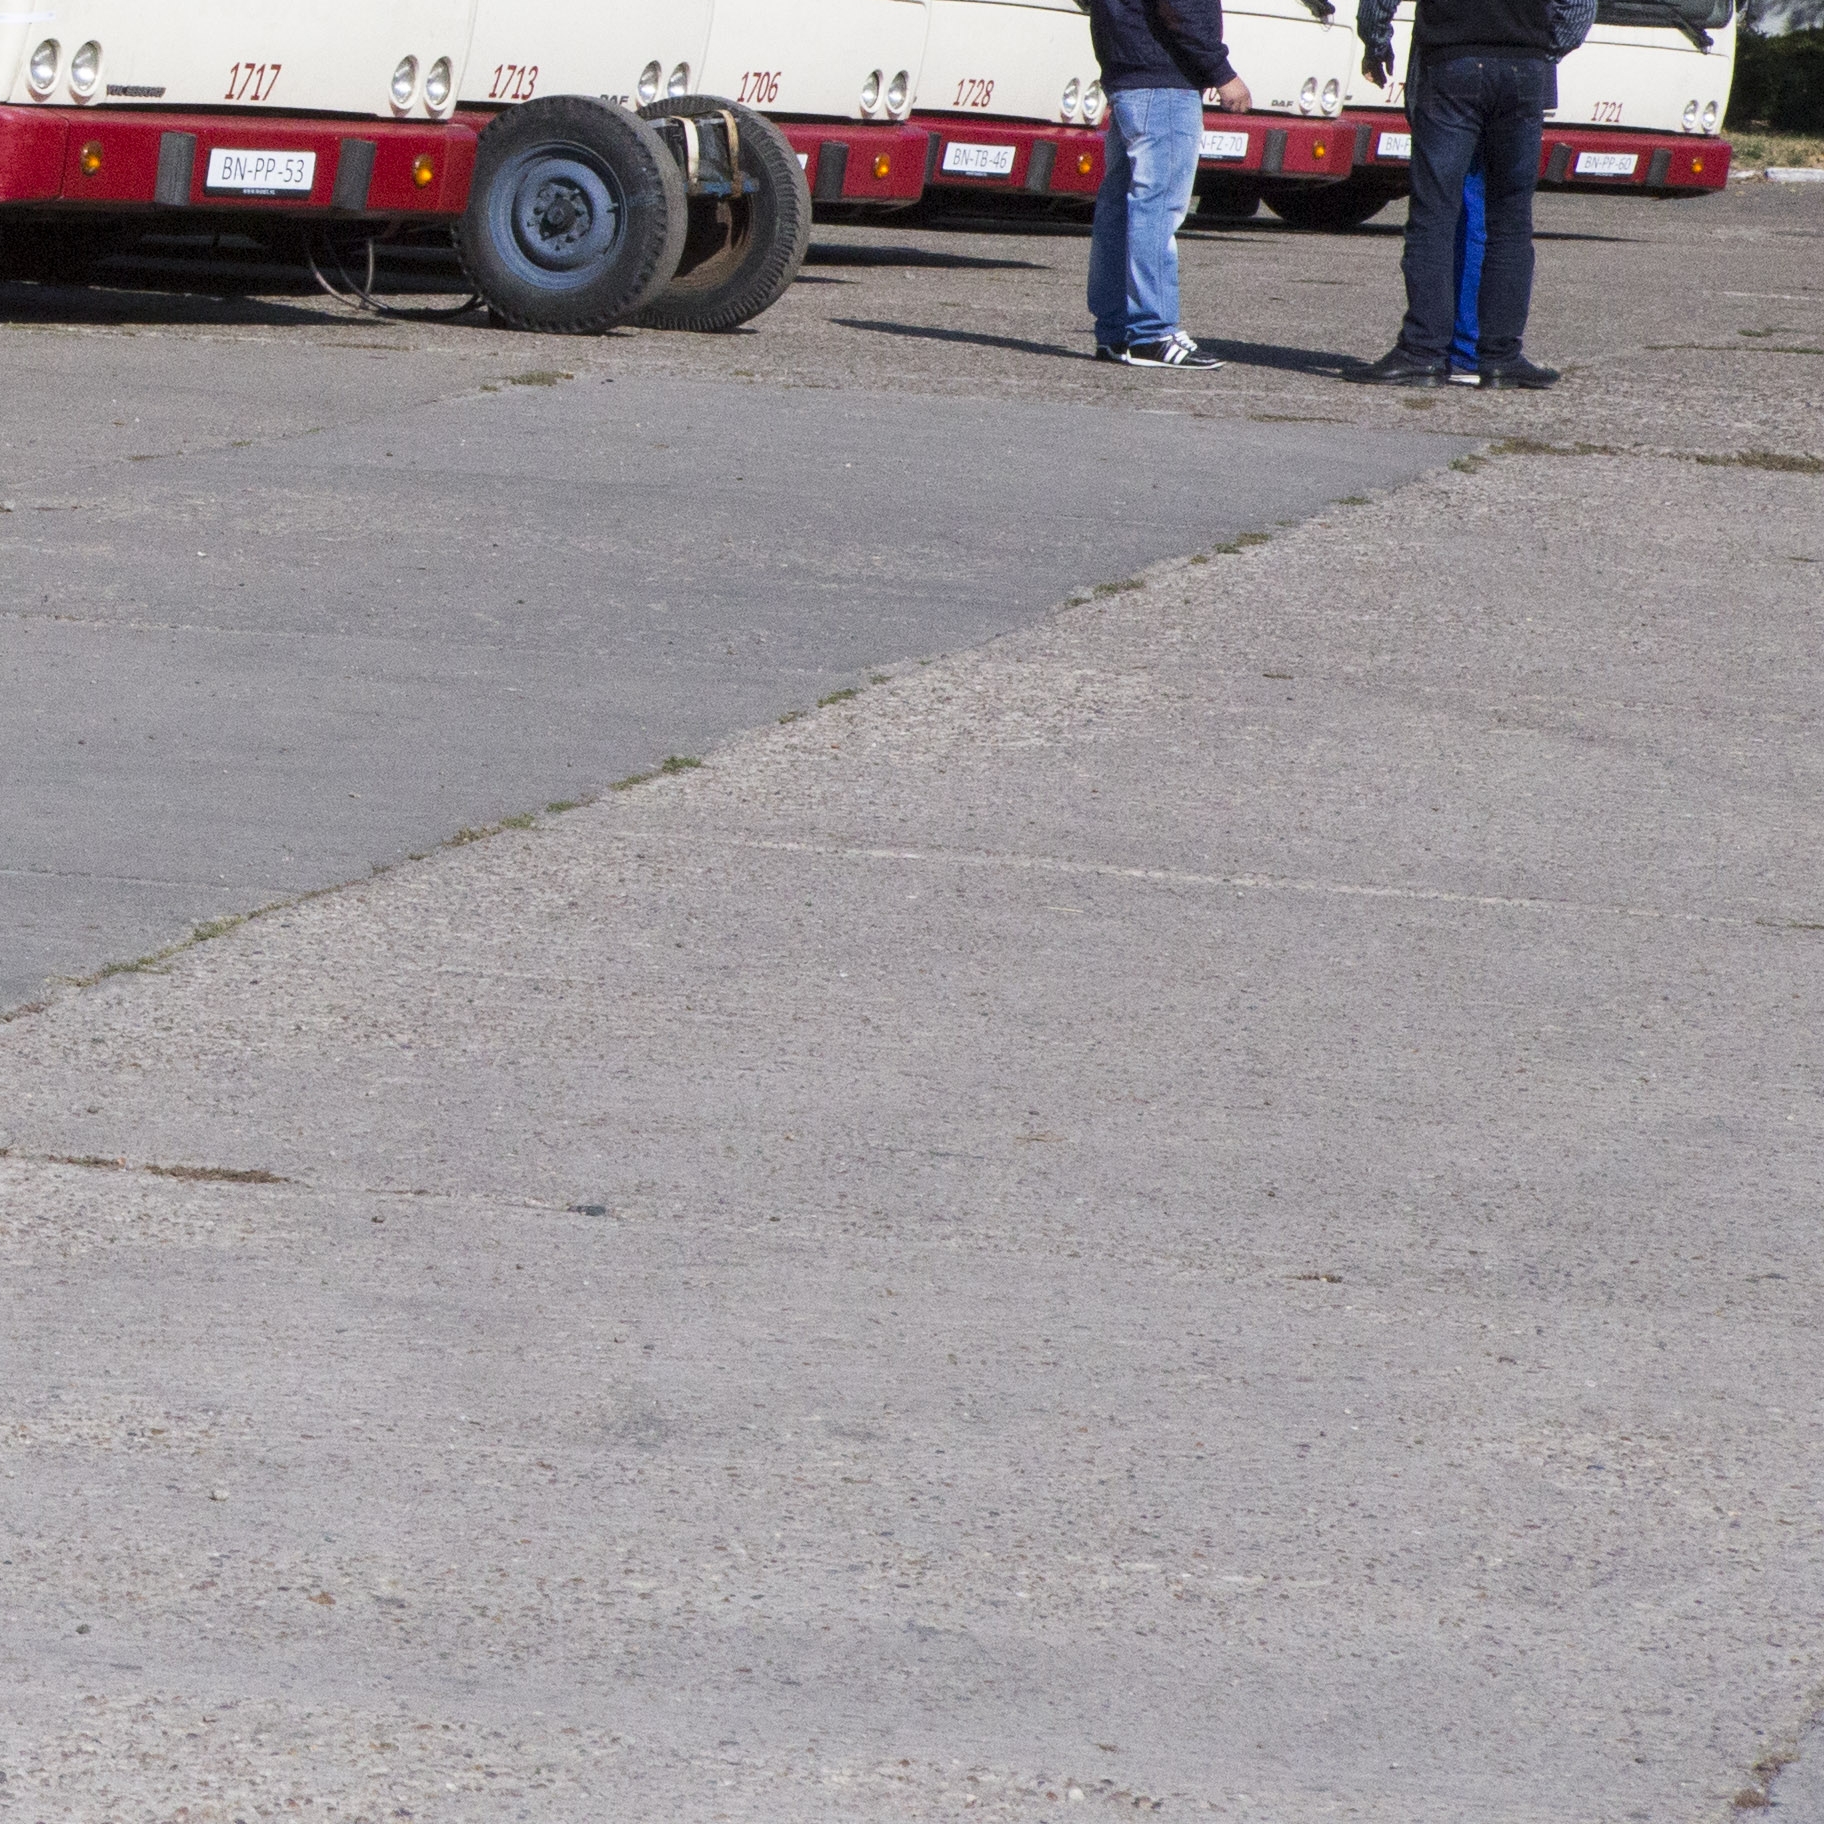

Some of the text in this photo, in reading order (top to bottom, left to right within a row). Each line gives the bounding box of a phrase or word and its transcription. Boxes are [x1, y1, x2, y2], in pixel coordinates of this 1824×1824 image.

[224, 61, 282, 101] 1717
[488, 64, 539, 101] 1713
[737, 71, 782, 103] 1706
[952, 78, 995, 107] 1728
[1385, 81, 1406, 104] 17
[1591, 101, 1623, 123] 1721
[1200, 134, 1243, 152] N-FZ-70
[221, 156, 305, 183] BN-PP-53
[952, 148, 1008, 169] BN-TB-46
